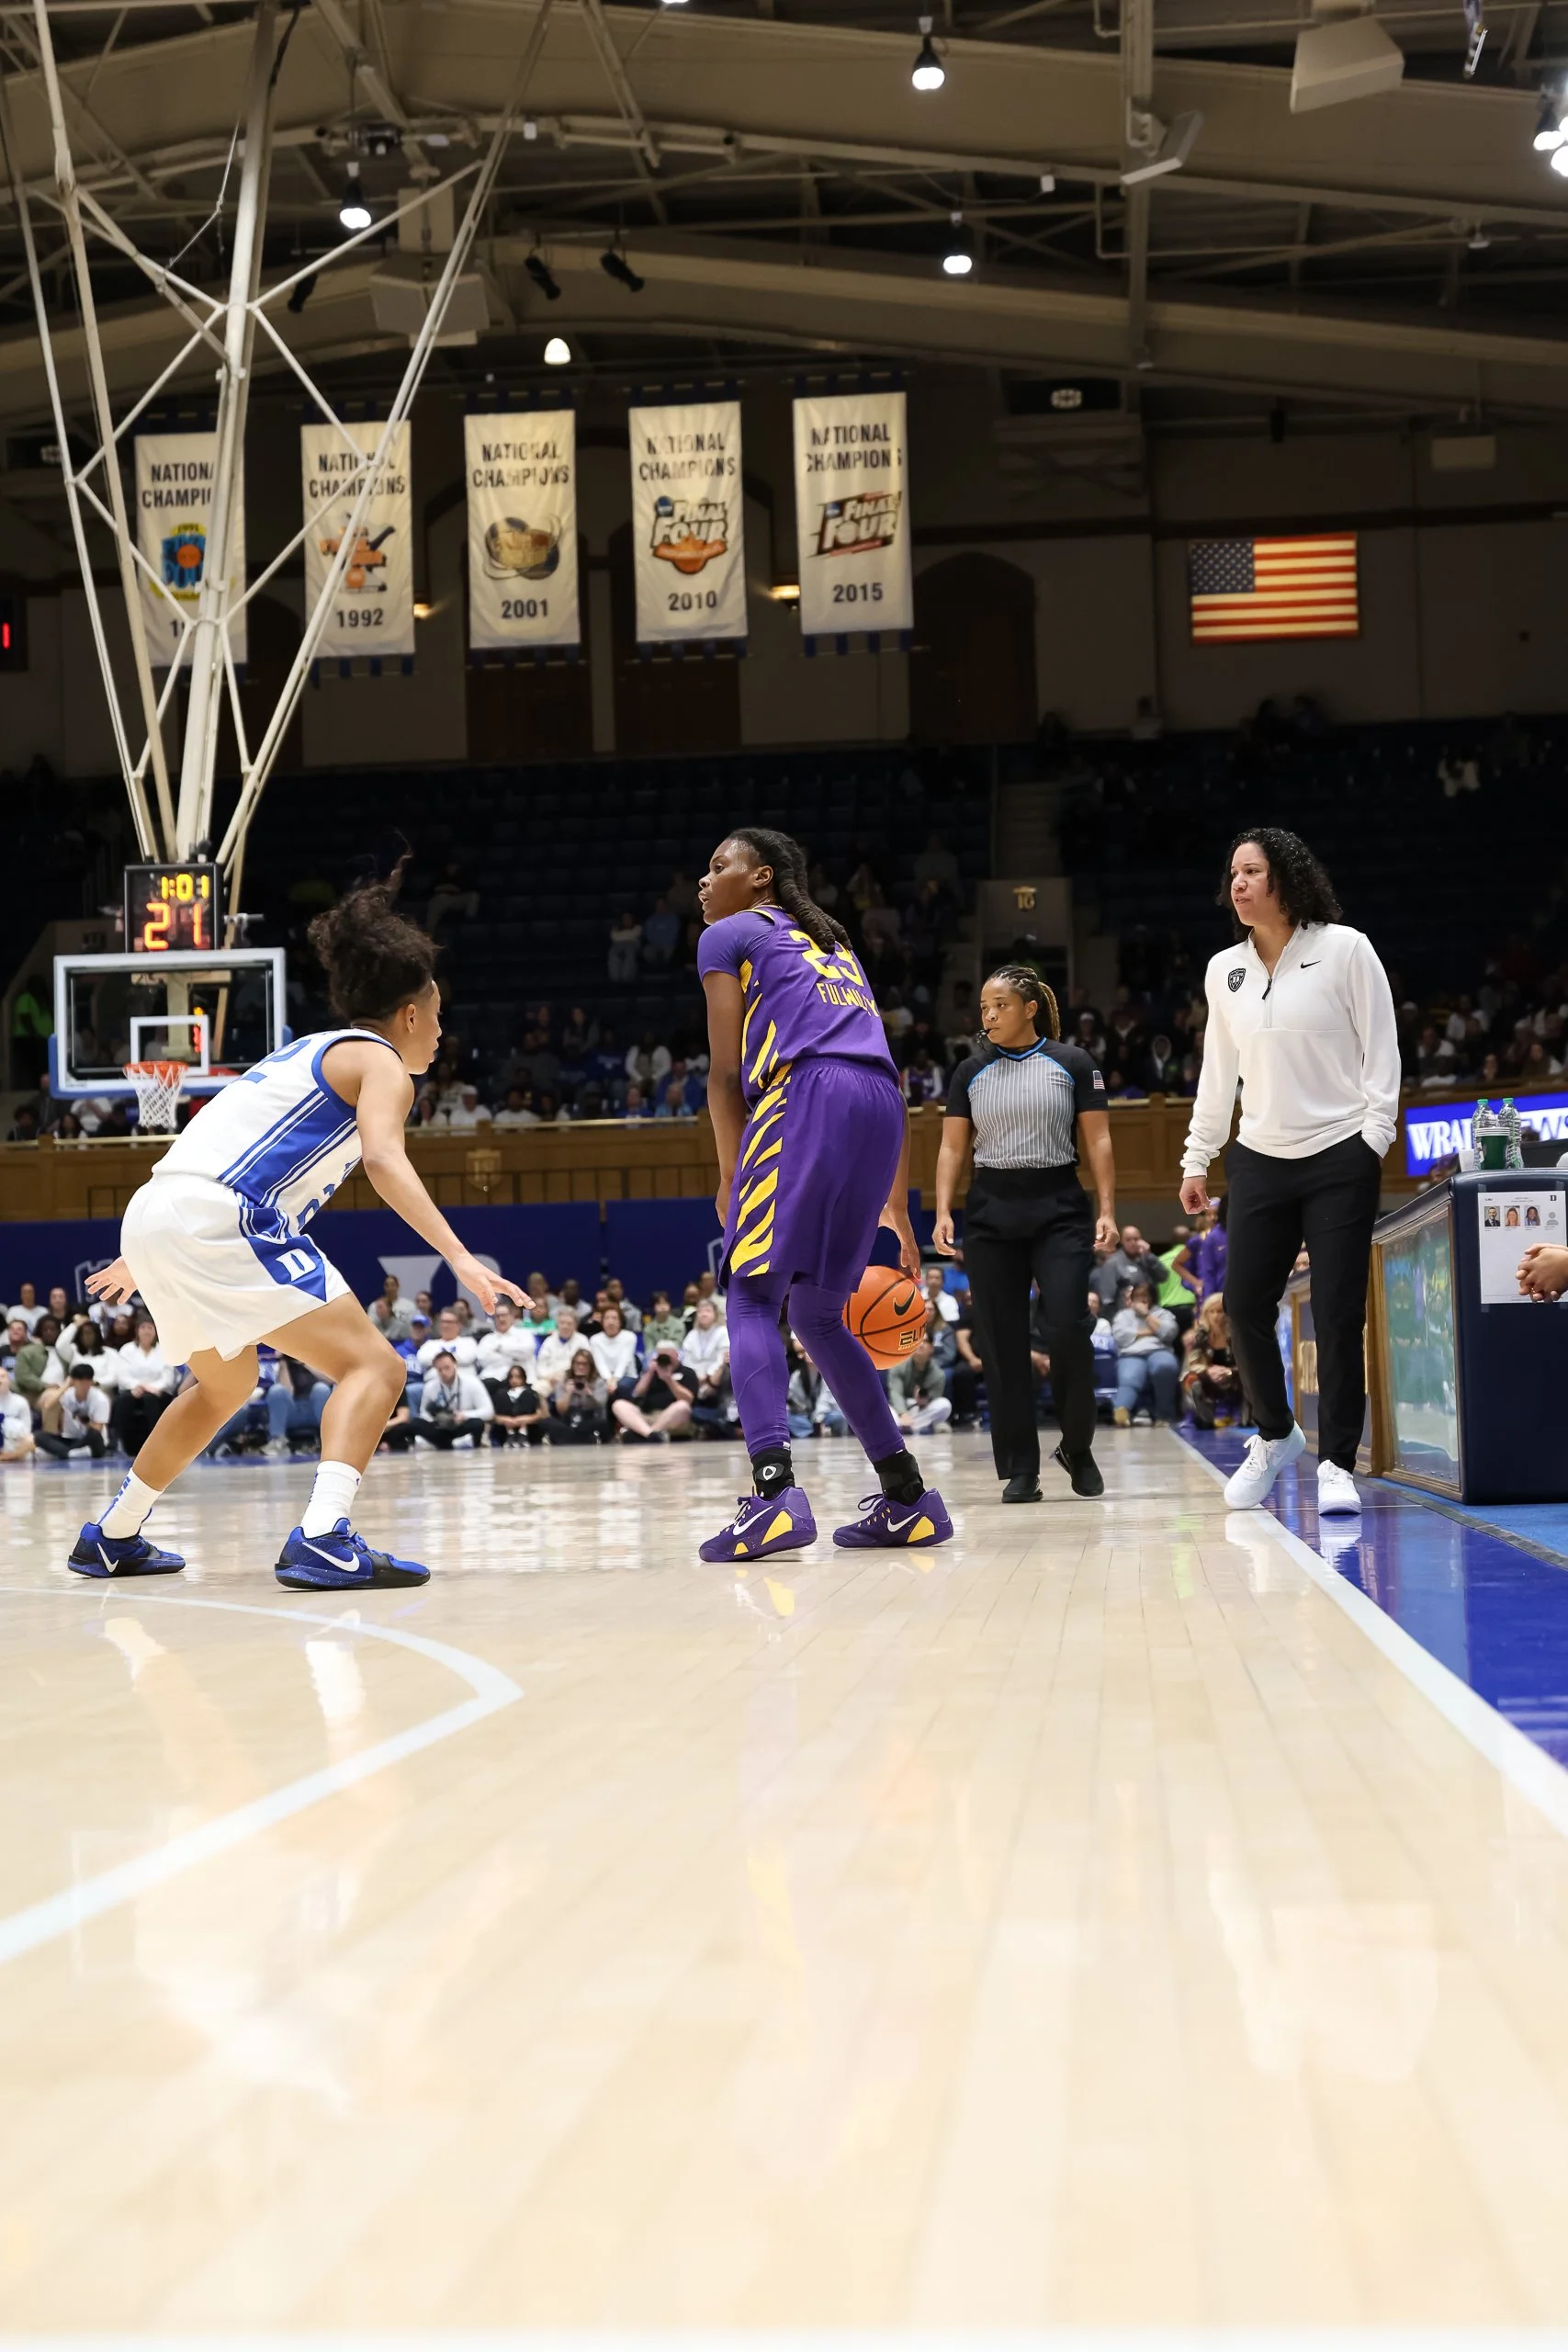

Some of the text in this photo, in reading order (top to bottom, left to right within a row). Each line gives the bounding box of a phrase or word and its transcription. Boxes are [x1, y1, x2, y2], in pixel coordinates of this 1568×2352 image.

[648, 432, 725, 455] NATIONAL
[812, 424, 891, 446] NATIONAL
[482, 441, 560, 461] NATIONAL
[806, 448, 902, 472] CHAMPIONS
[152, 462, 214, 482] NATION
[473, 466, 570, 488] CHAMPIONS
[639, 457, 736, 481] CHAMPIONS
[141, 488, 211, 508] CHAMPI
[650, 519, 728, 548] FOUR
[822, 513, 897, 550] FOUR
[669, 591, 716, 611] 2010
[833, 583, 884, 603] 2015
[336, 608, 384, 628] 1992
[502, 599, 548, 619] 2001
[161, 873, 210, 901] 1:01
[144, 902, 203, 950] 21
[788, 929, 865, 987] 23
[276, 1248, 317, 1283] D
